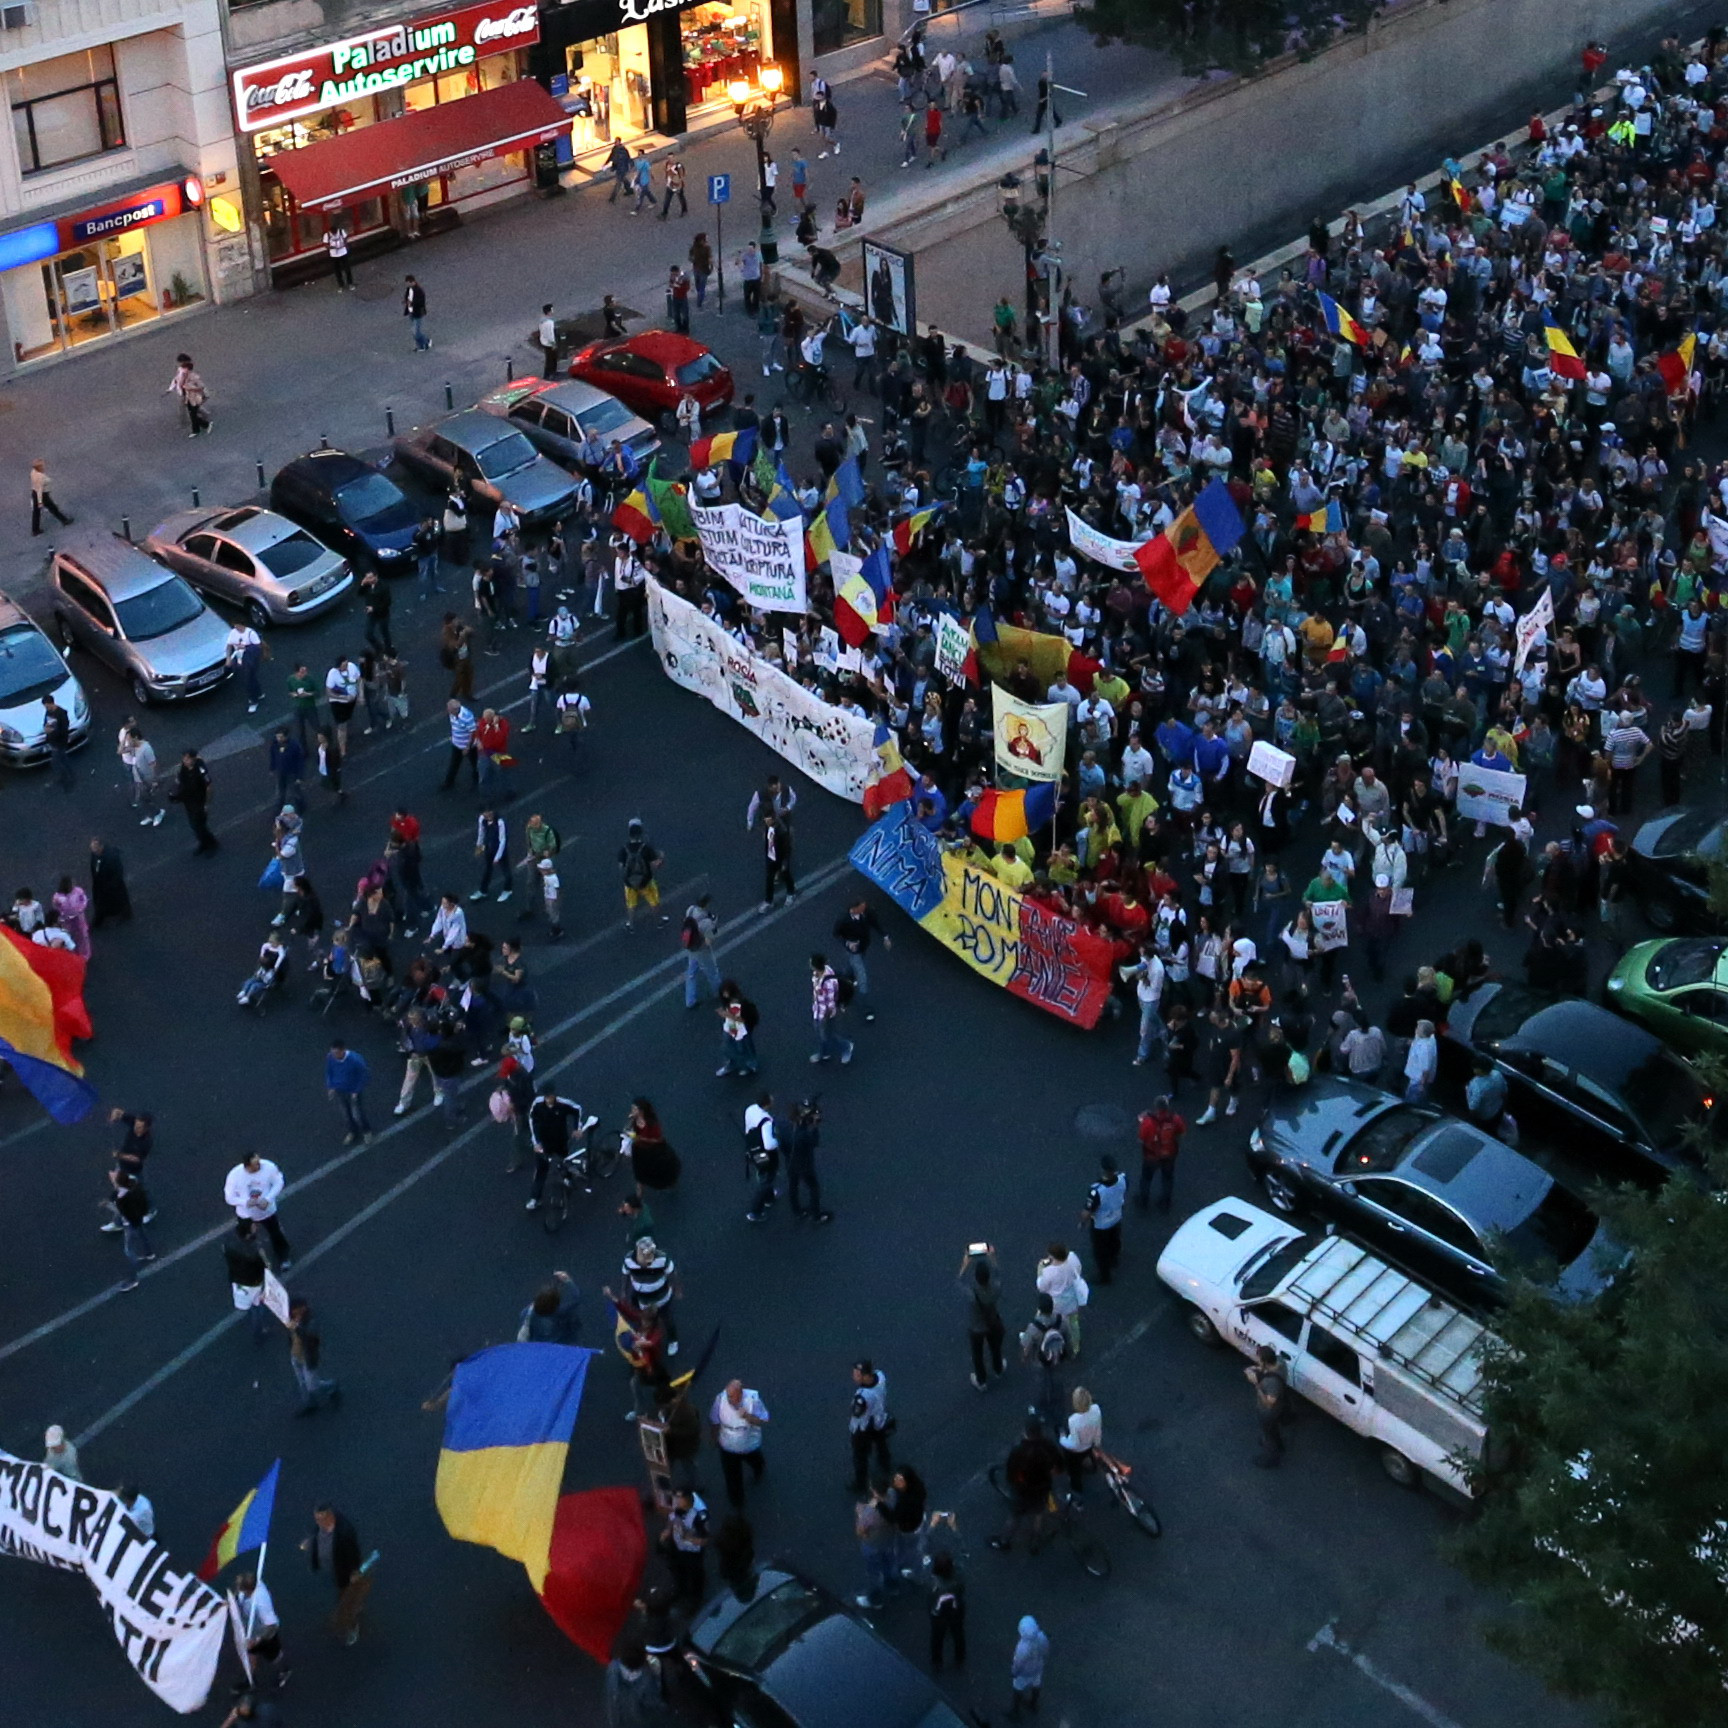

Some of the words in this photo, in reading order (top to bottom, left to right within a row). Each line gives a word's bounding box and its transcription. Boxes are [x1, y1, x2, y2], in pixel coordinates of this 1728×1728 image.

[331, 21, 458, 76] Paladium
[318, 44, 476, 104] Autoservire
[391, 167, 438, 189] PALADIUM
[438, 149, 495, 173] AUTOSERVIRE
[713, 176, 725, 200] P
[86, 203, 156, 235] Bancpost
